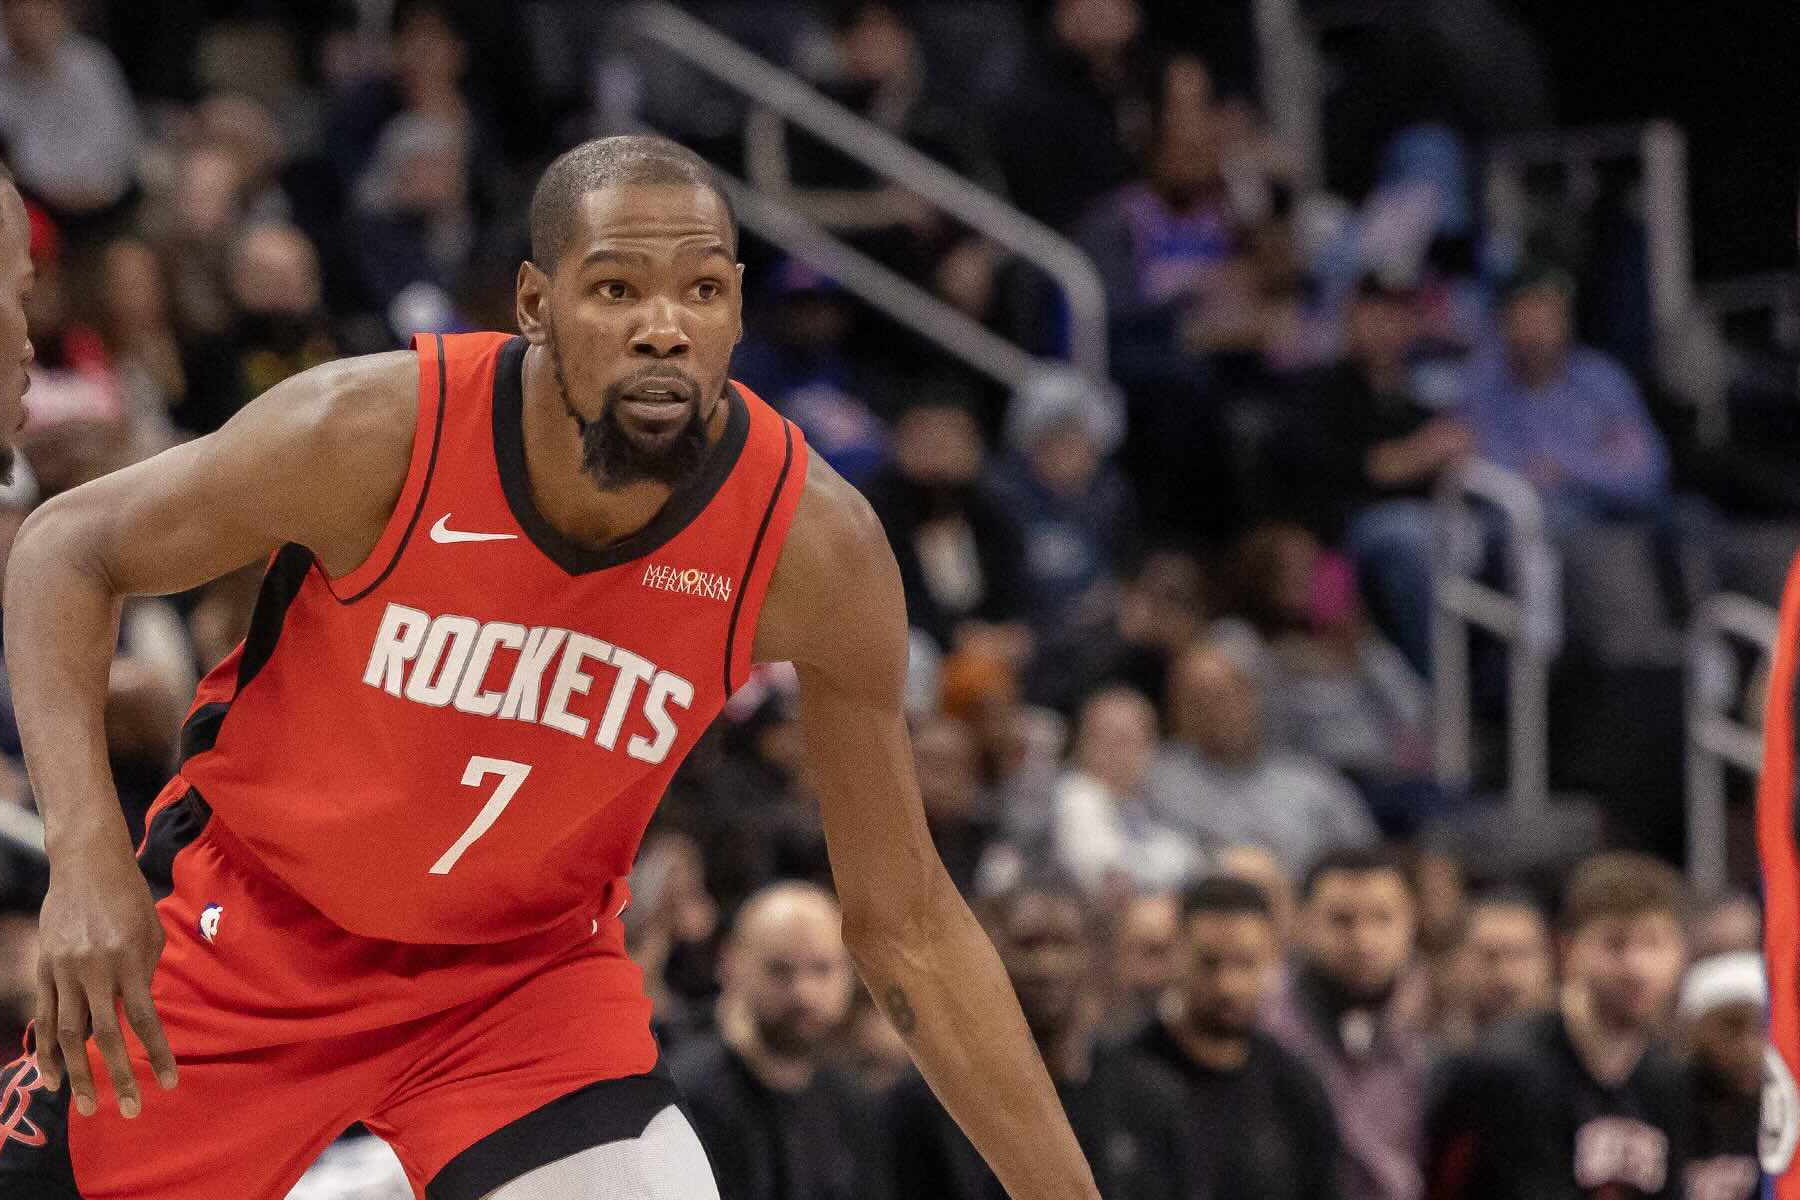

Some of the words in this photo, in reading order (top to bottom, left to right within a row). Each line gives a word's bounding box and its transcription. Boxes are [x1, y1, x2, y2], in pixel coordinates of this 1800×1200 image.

[642, 575, 731, 602] HERMANN
[645, 563, 732, 591] MEMORIAL
[362, 601, 695, 765] ROCKETS
[428, 755, 533, 875] 7
